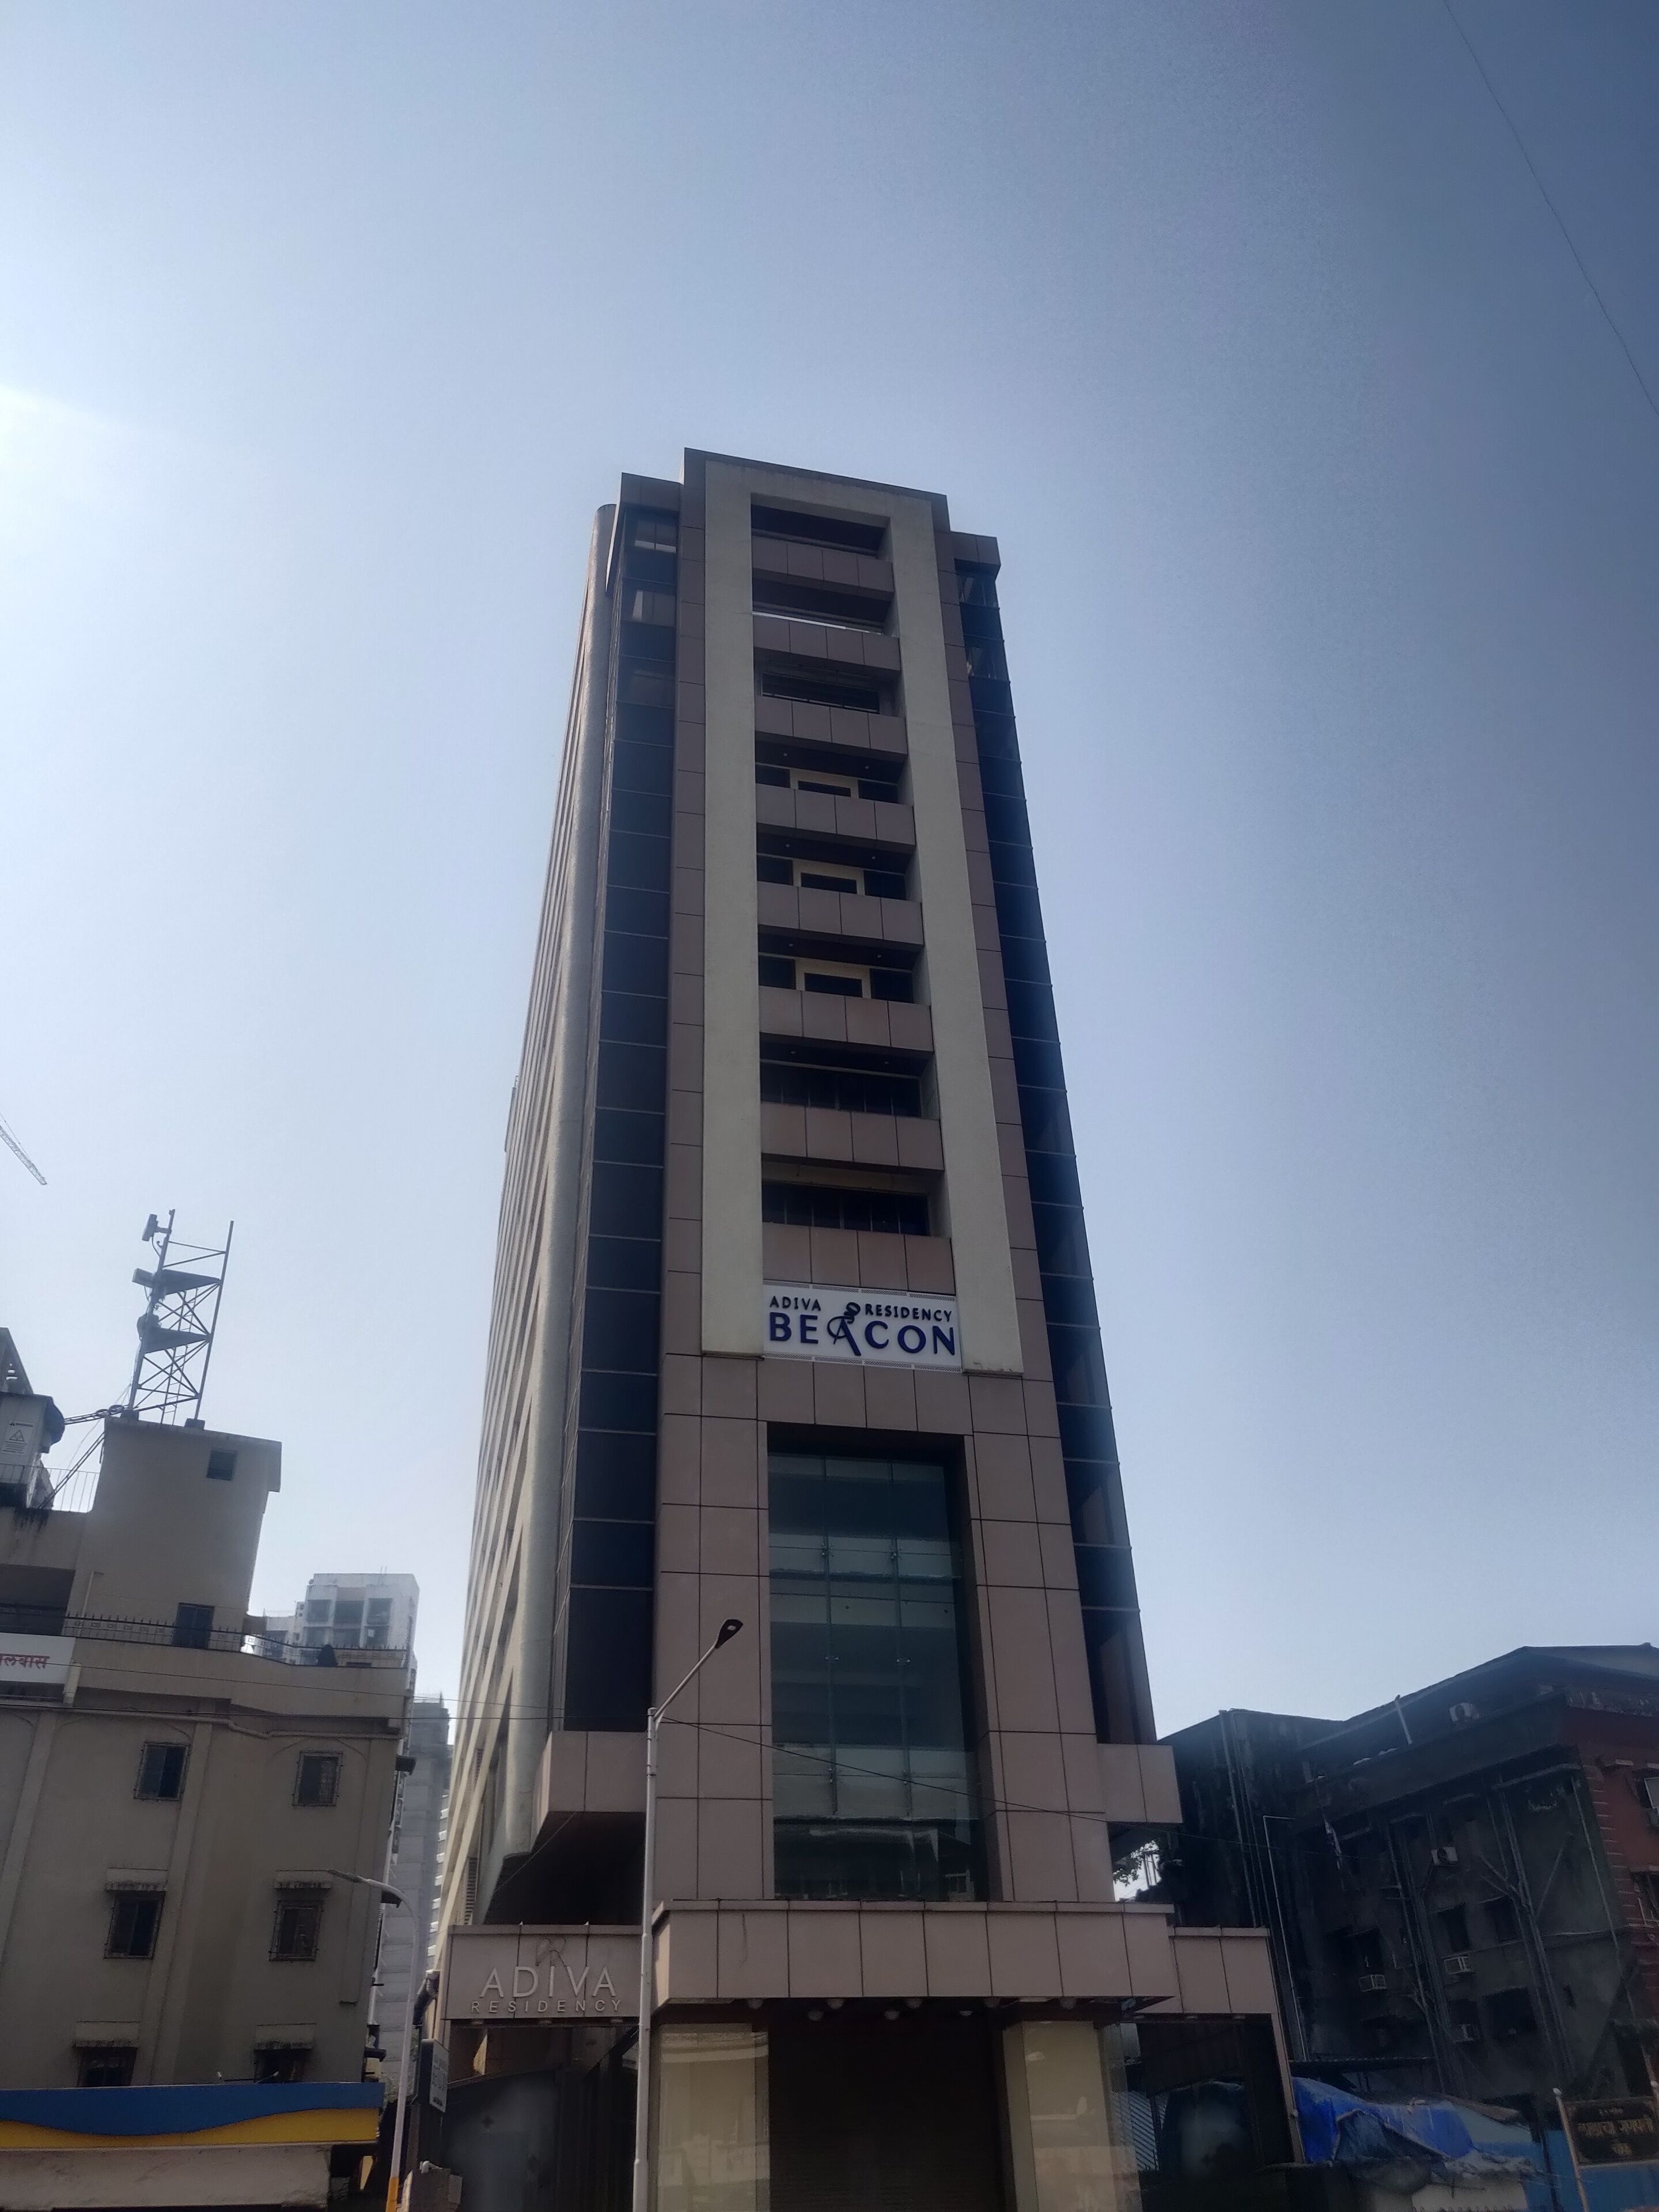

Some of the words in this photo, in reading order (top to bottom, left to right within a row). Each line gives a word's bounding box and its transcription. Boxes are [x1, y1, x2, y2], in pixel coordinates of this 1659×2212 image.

[769, 1296, 821, 1312] ADIVA
[865, 1303, 952, 1322] RESIDENCY
[769, 1312, 955, 1356] BEACON
[479, 1965, 616, 1998] ADIVA
[470, 1999, 622, 2013] RESIDENCY
